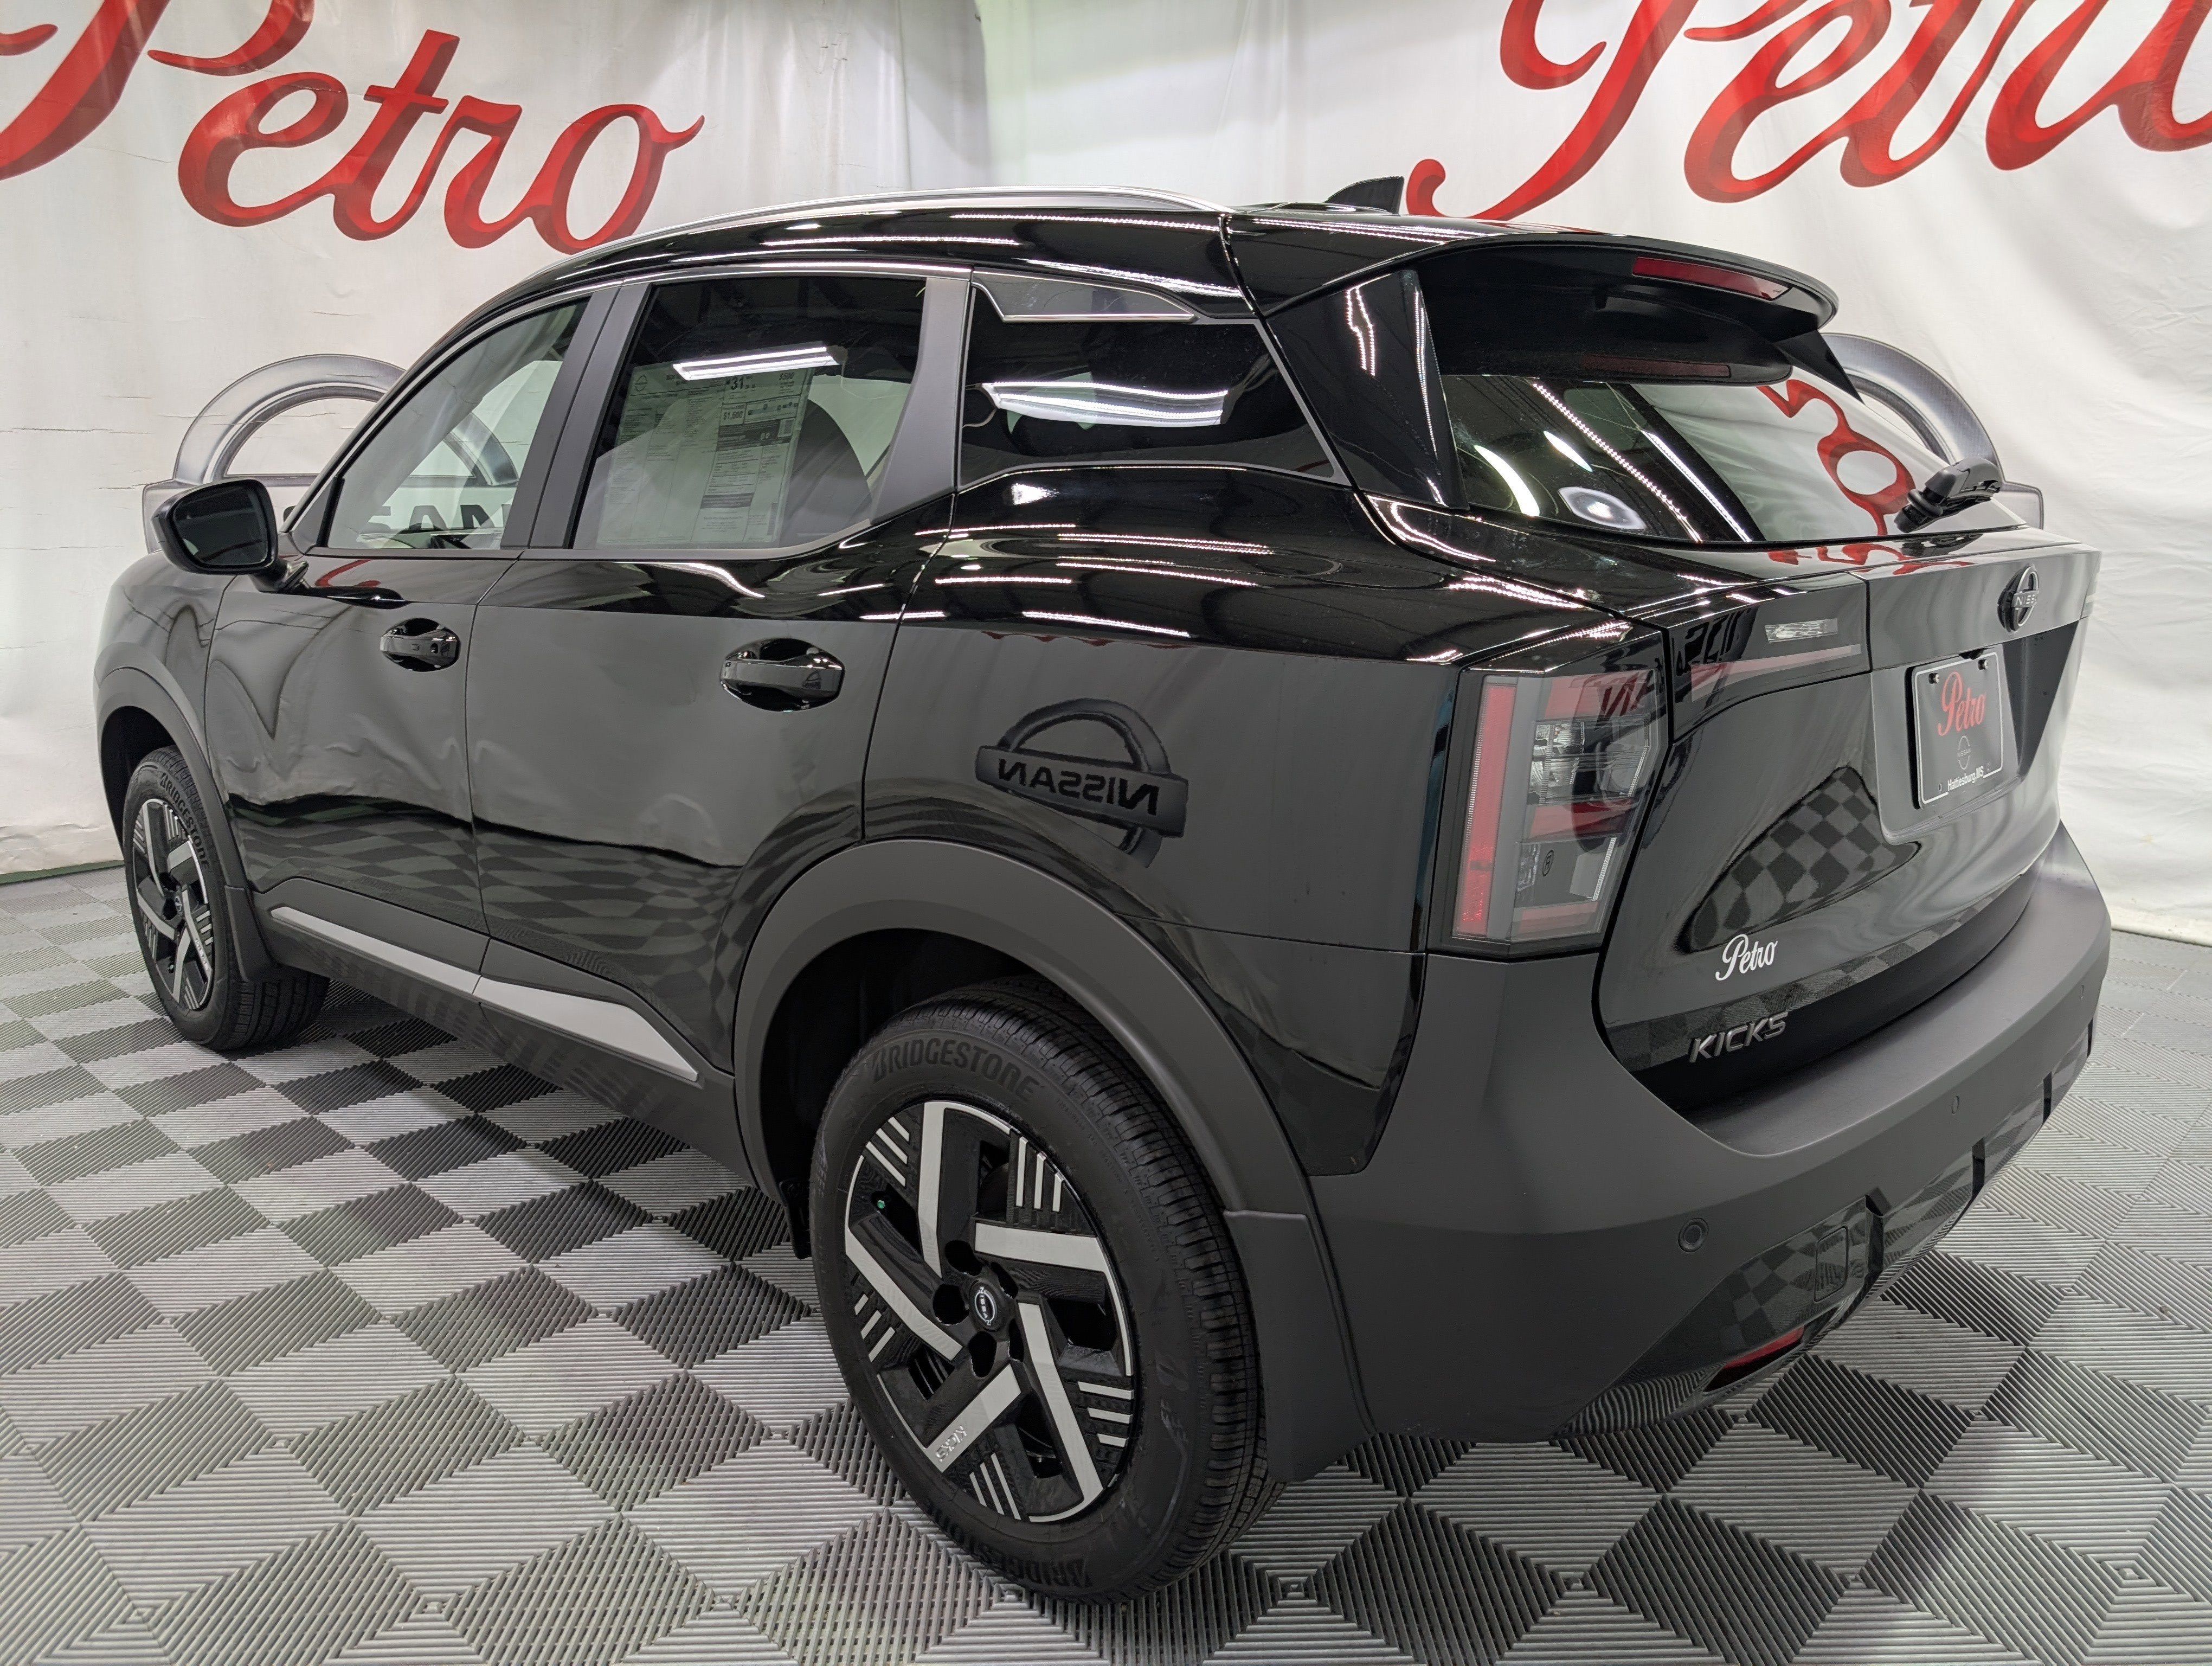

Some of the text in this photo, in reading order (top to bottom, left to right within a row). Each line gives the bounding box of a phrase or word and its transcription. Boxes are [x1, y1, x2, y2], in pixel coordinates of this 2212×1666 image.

[1937, 671, 1987, 736] Petro
[160, 772, 210, 870] BRIDGESTONE
[1715, 933, 1778, 981] Petro
[1688, 1011, 1789, 1063] KICKS
[871, 1037, 1041, 1103] BRIDGESTONE
